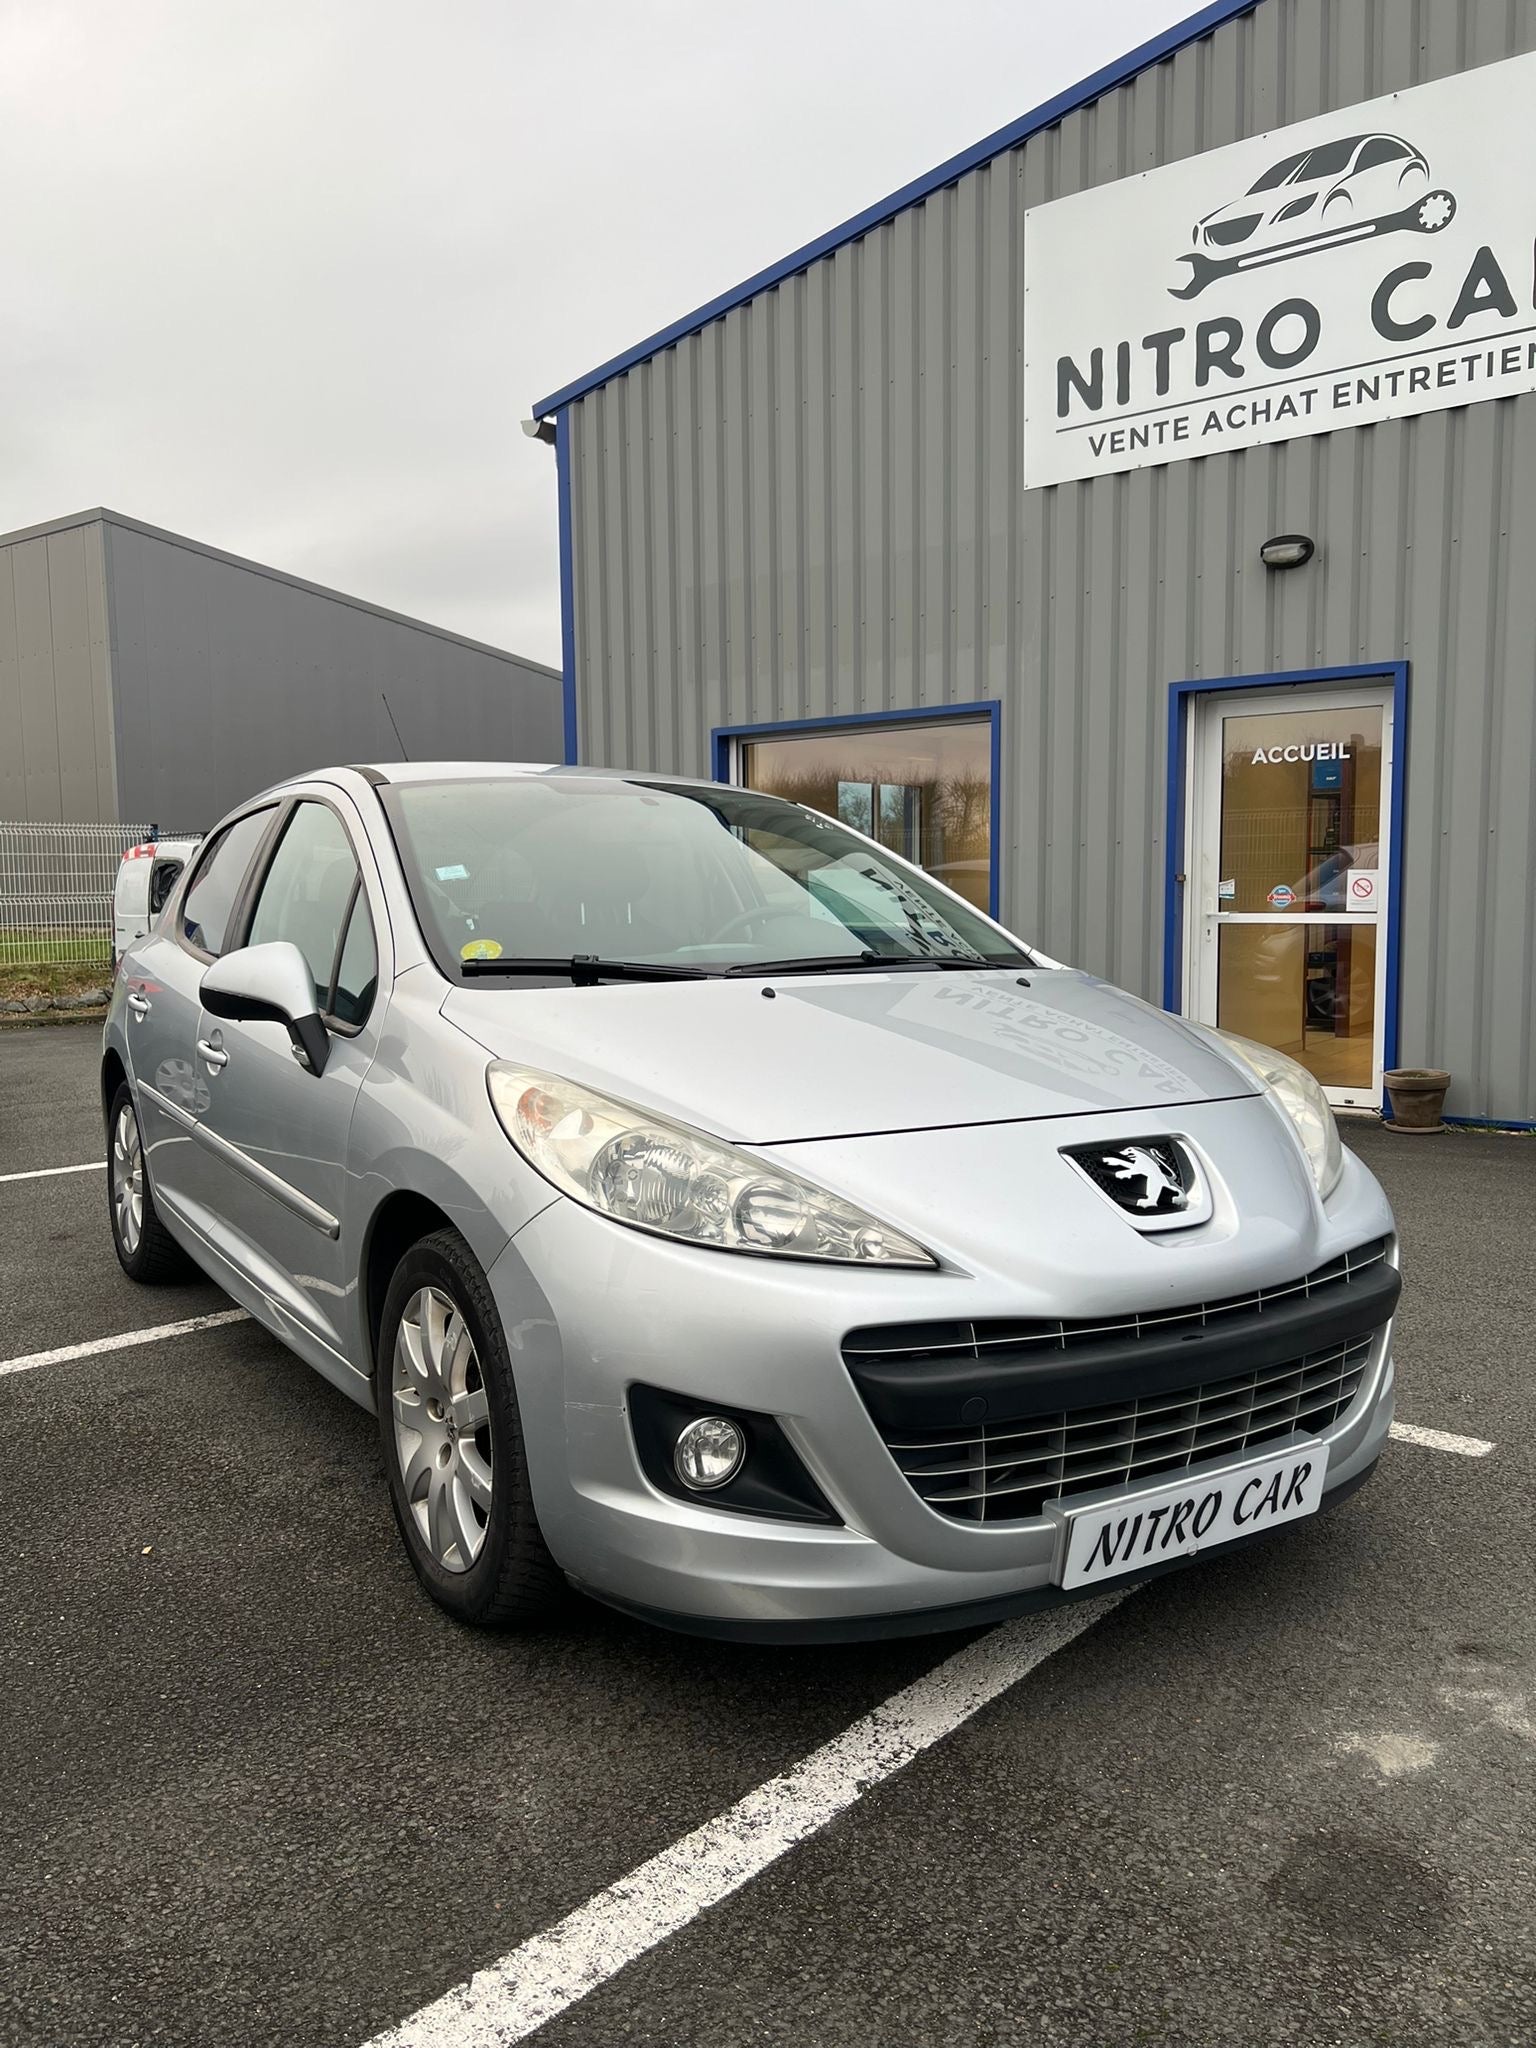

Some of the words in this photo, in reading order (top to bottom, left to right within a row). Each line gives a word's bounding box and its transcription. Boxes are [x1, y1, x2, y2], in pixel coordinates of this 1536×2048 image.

[1056, 297, 1321, 418] NITRO
[1370, 237, 1536, 342] CA
[1088, 415, 1190, 457] VENTE
[1201, 388, 1319, 436] ACHAT
[1251, 742, 1351, 765] ACCUEIL
[1083, 1490, 1223, 1573] NITRO
[1232, 1461, 1312, 1526] CAR
